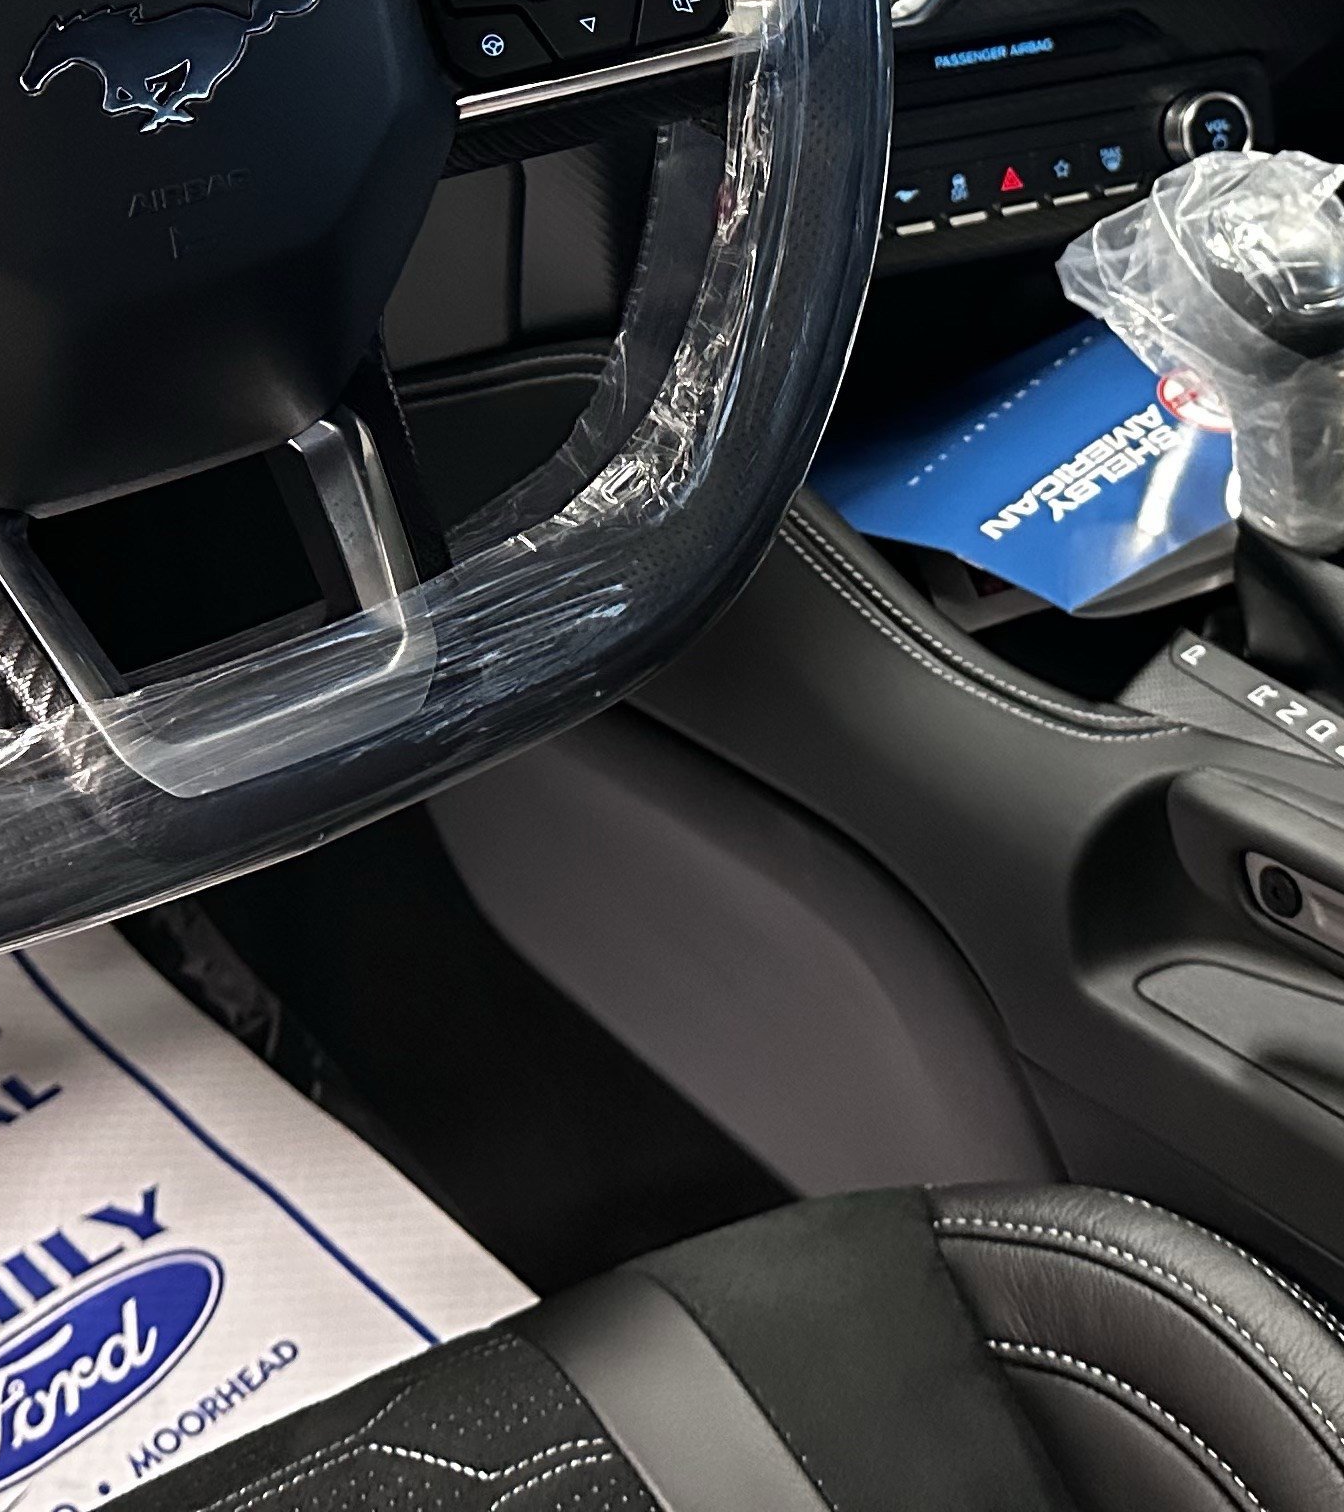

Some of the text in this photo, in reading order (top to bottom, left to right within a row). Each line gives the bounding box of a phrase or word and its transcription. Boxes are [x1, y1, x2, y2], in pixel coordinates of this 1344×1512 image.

[935, 37, 1054, 68] PASSENGER AIRBAG
[979, 403, 1164, 541] AMERICAN
[1049, 424, 1181, 522] SHELBY
[1180, 644, 1206, 666] P
[1247, 684, 1279, 707] R
[1275, 700, 1308, 726] N
[1306, 719, 1338, 743] D
[126, 1339, 300, 1480] MOORHEAD
